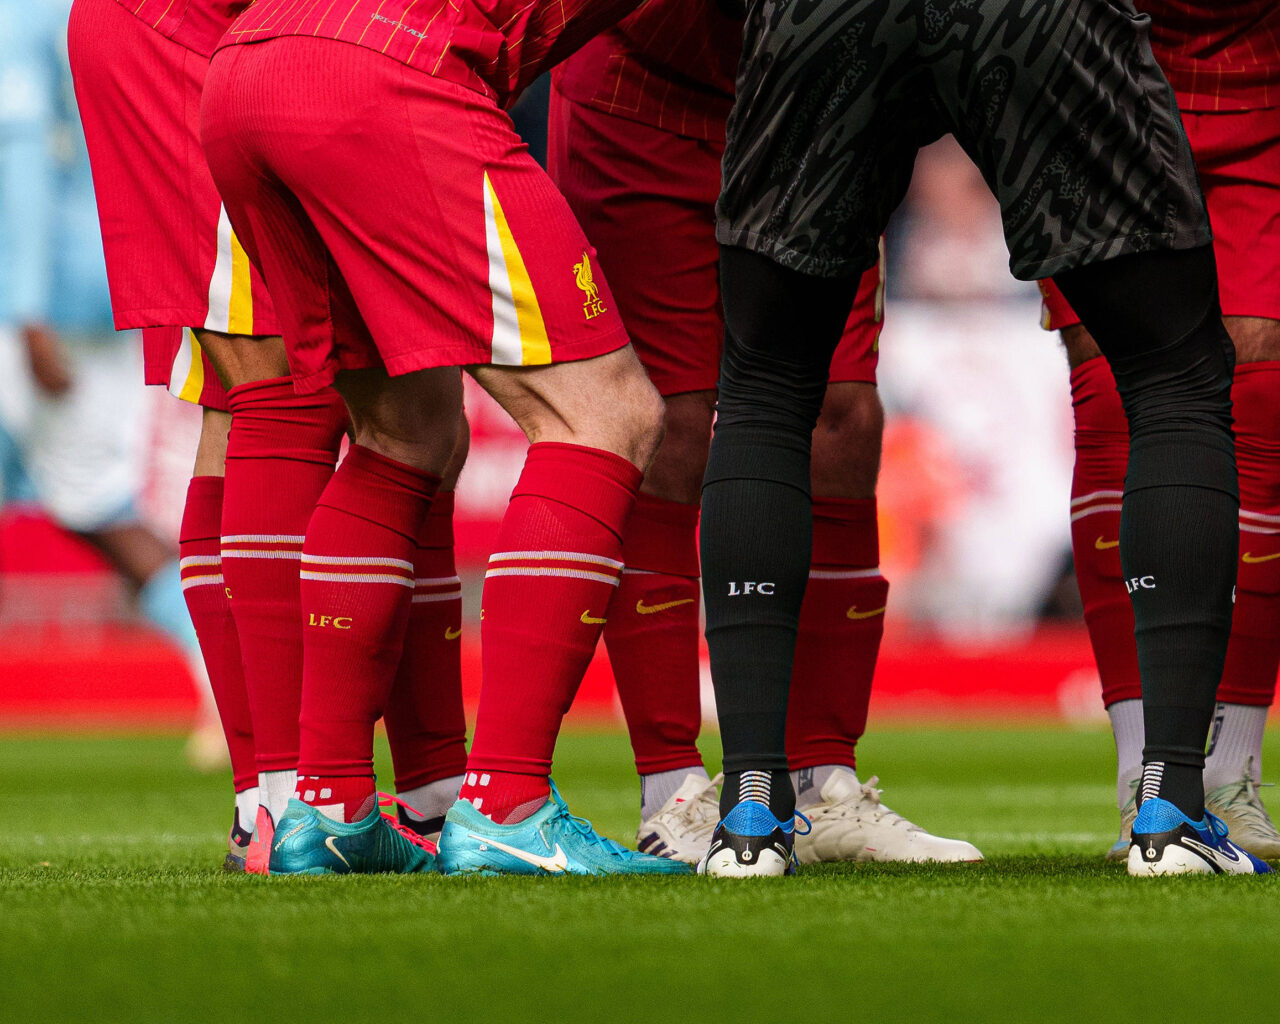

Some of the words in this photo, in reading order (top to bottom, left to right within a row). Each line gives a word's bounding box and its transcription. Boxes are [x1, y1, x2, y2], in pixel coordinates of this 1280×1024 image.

[728, 580, 775, 597] LFC
[1125, 575, 1156, 594] LFC
[308, 613, 353, 629] LFC
